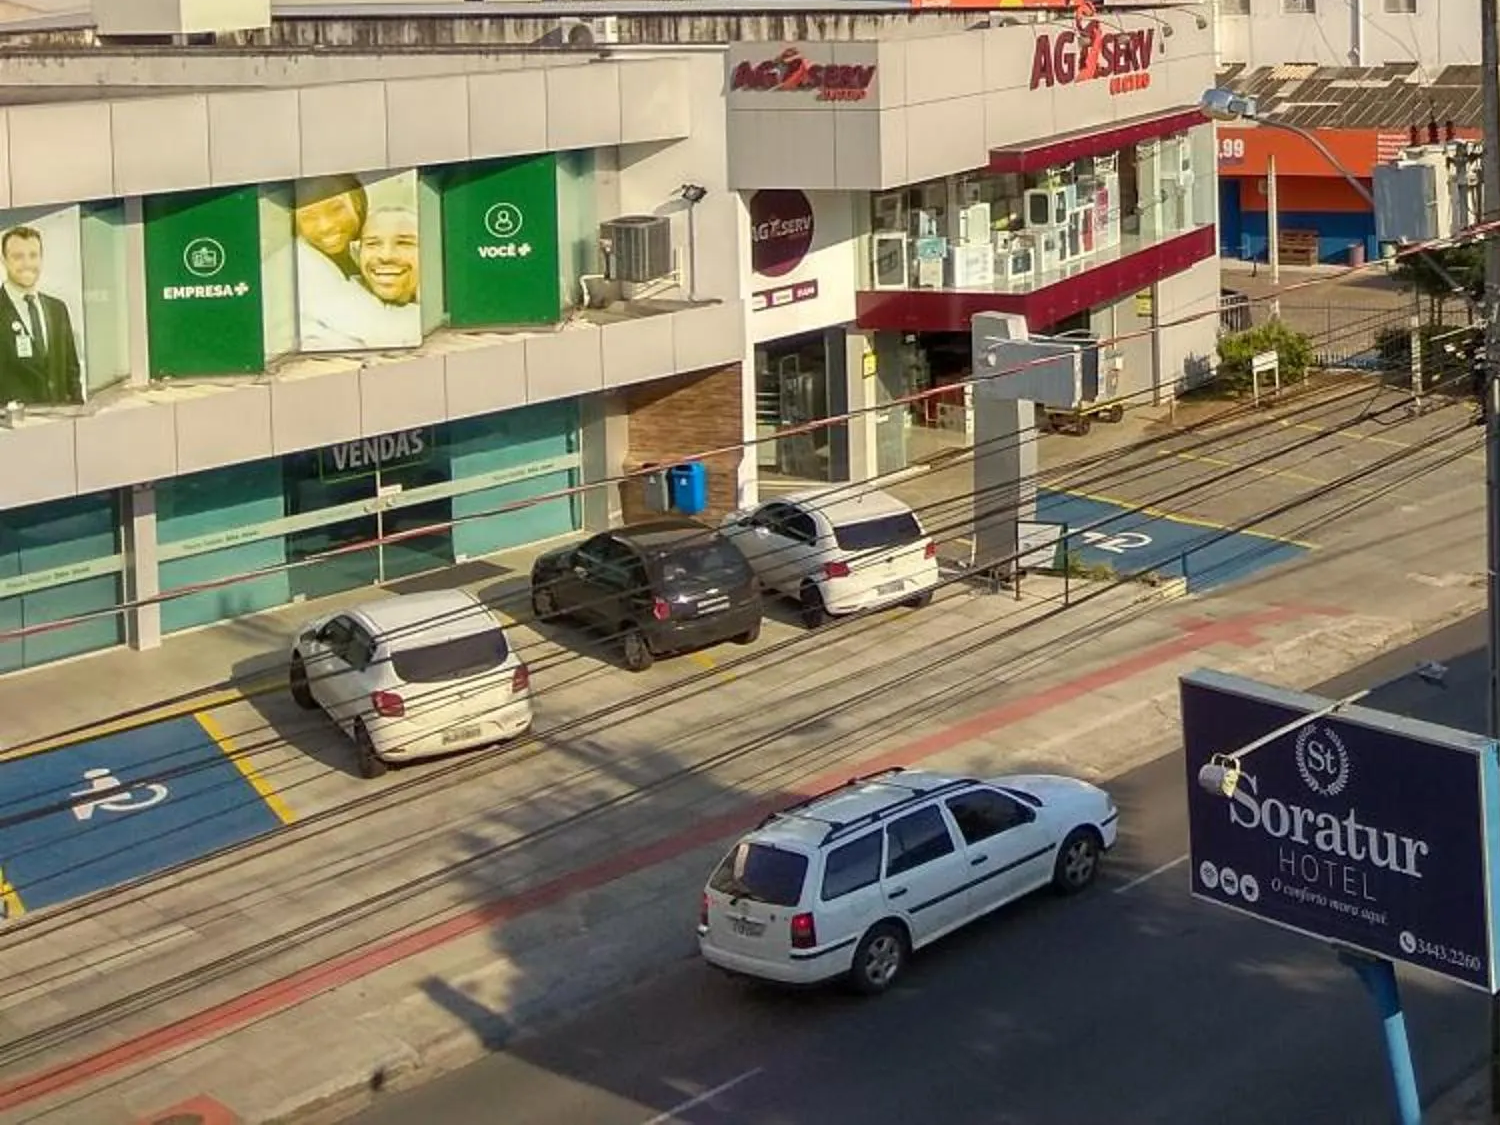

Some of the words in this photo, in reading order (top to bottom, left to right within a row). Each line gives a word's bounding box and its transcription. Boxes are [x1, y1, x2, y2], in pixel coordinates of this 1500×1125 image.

[332, 428, 424, 471] VENDAS
[1229, 771, 1429, 878] Soratur
[1279, 846, 1377, 902] HOTEL
